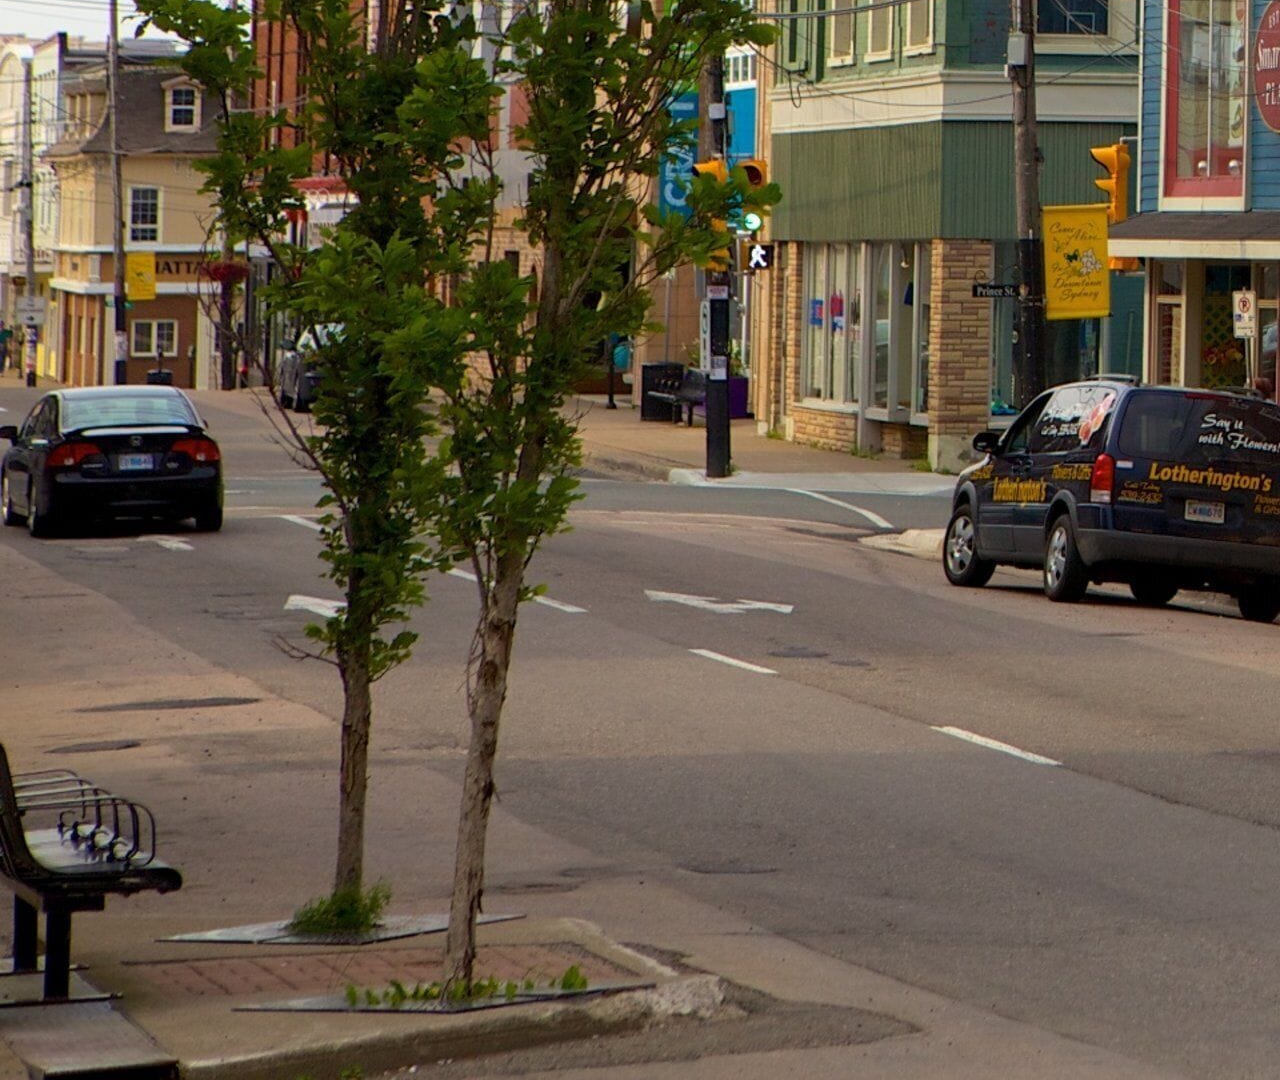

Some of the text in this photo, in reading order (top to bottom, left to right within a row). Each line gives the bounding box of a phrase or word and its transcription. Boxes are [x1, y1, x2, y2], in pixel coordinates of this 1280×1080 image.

[1053, 277, 1102, 289] Downtown
[976, 286, 1003, 297] Prince
[1059, 287, 1100, 302] Sydney
[1200, 413, 1230, 431] Say
[1198, 432, 1224, 446] with
[1149, 461, 1272, 492] Lotherington's
[993, 477, 1047, 504] Lotherington's
